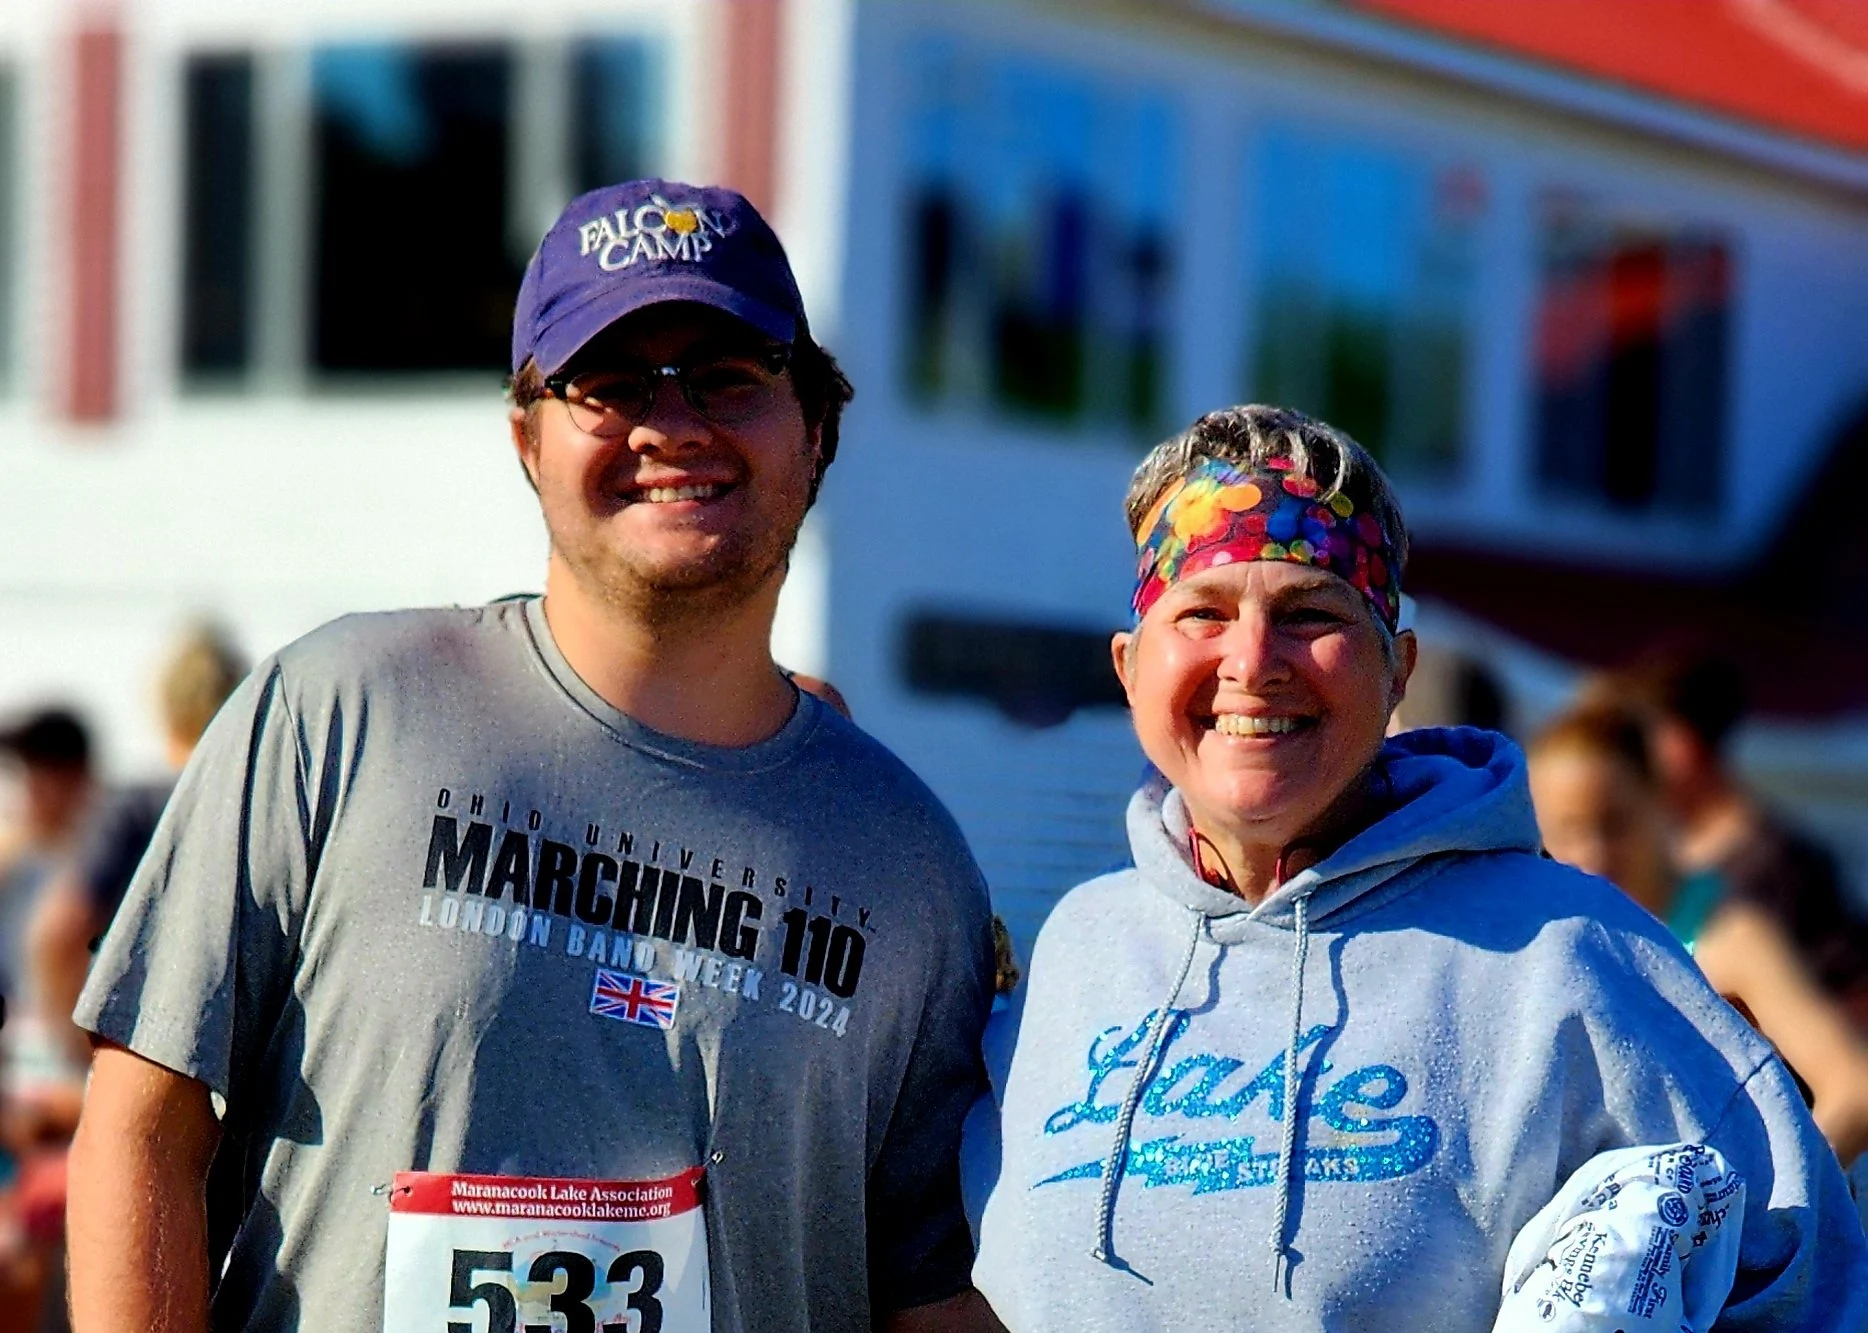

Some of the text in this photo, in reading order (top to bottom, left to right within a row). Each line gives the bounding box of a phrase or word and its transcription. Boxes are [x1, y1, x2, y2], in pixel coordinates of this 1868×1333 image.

[578, 198, 738, 256] FALCON
[599, 231, 712, 272] CAMP
[423, 815, 867, 998] MARCHING 110
[437, 788, 873, 929] OHIO UNIVERSITY
[419, 894, 853, 1038] LONDON BAND WEEK 2024
[1044, 1008, 1409, 1135] Lake
[451, 1181, 673, 1202] Maranacook Lake Association
